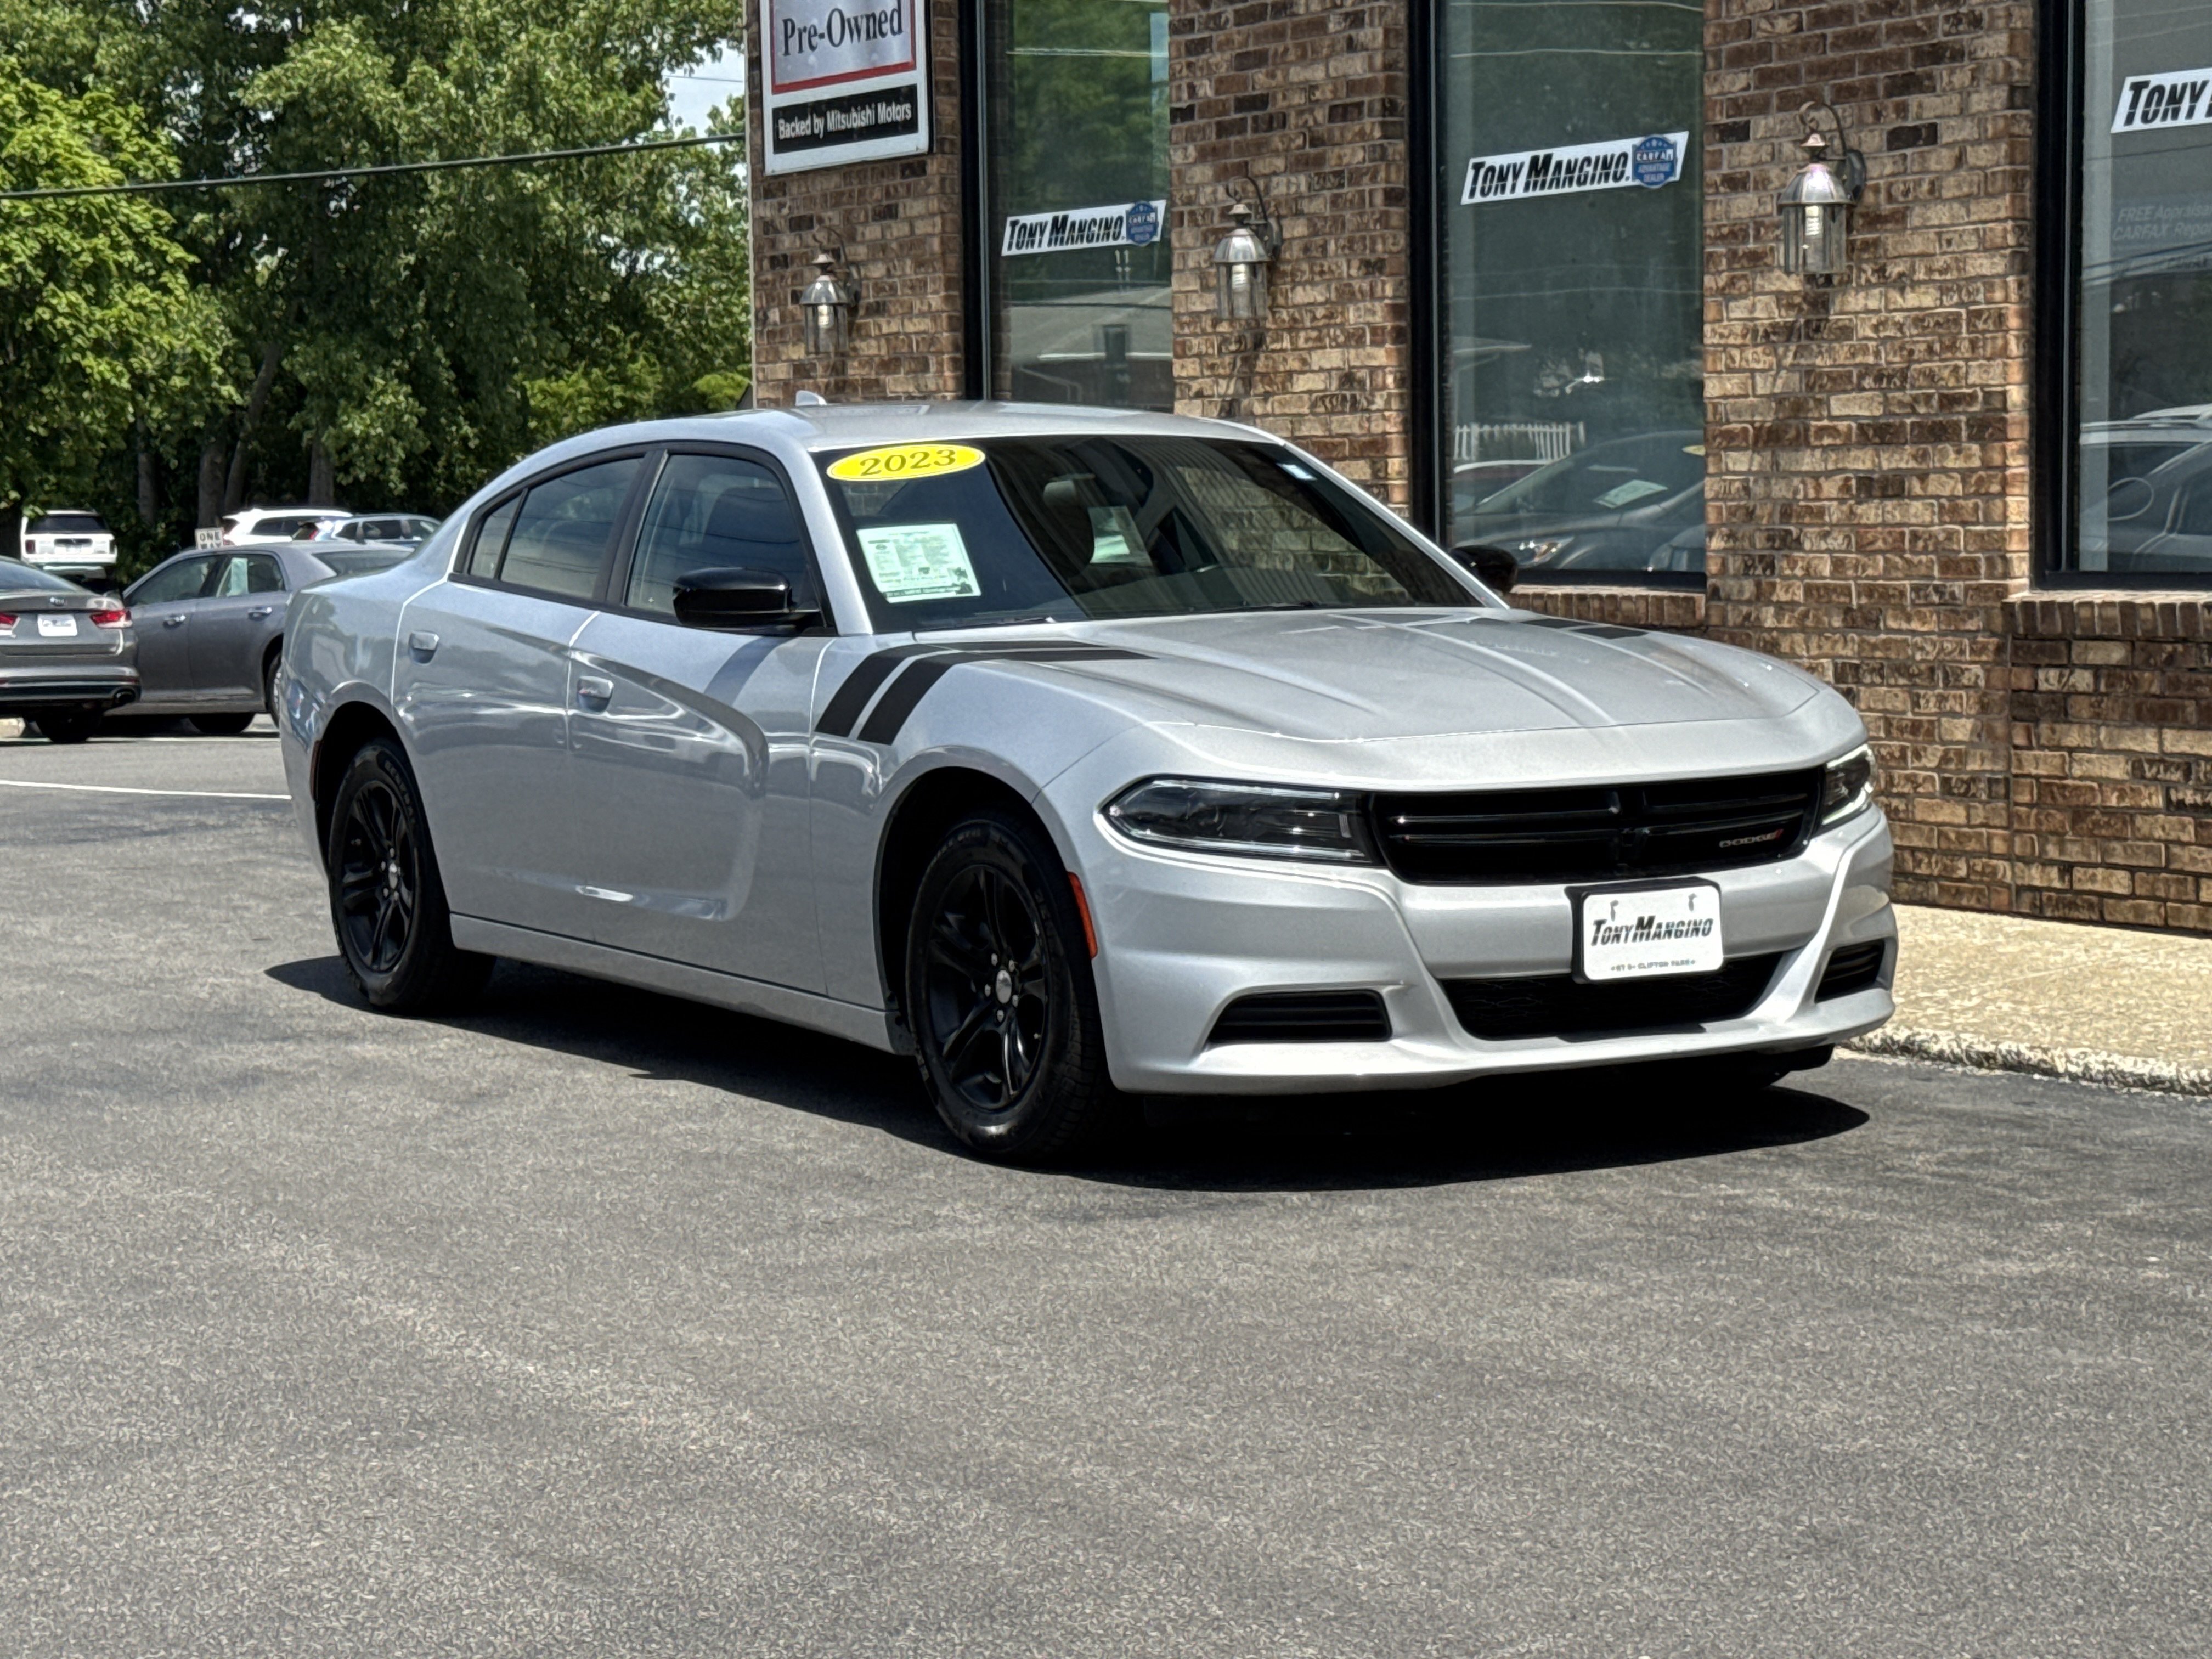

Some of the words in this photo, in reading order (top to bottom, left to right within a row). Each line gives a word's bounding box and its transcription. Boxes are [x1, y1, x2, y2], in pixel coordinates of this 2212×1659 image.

[782, 0, 904, 57] Pre-Owned
[778, 115, 811, 140] Backed
[813, 112, 825, 139] by
[826, 103, 876, 132] Mitsubishi
[878, 101, 912, 125] Motors
[2123, 80, 2210, 127] TONY
[1468, 161, 1525, 199] TONY
[1007, 219, 1048, 252] TONY
[860, 448, 956, 476] 2023
[199, 531, 220, 543] ONE
